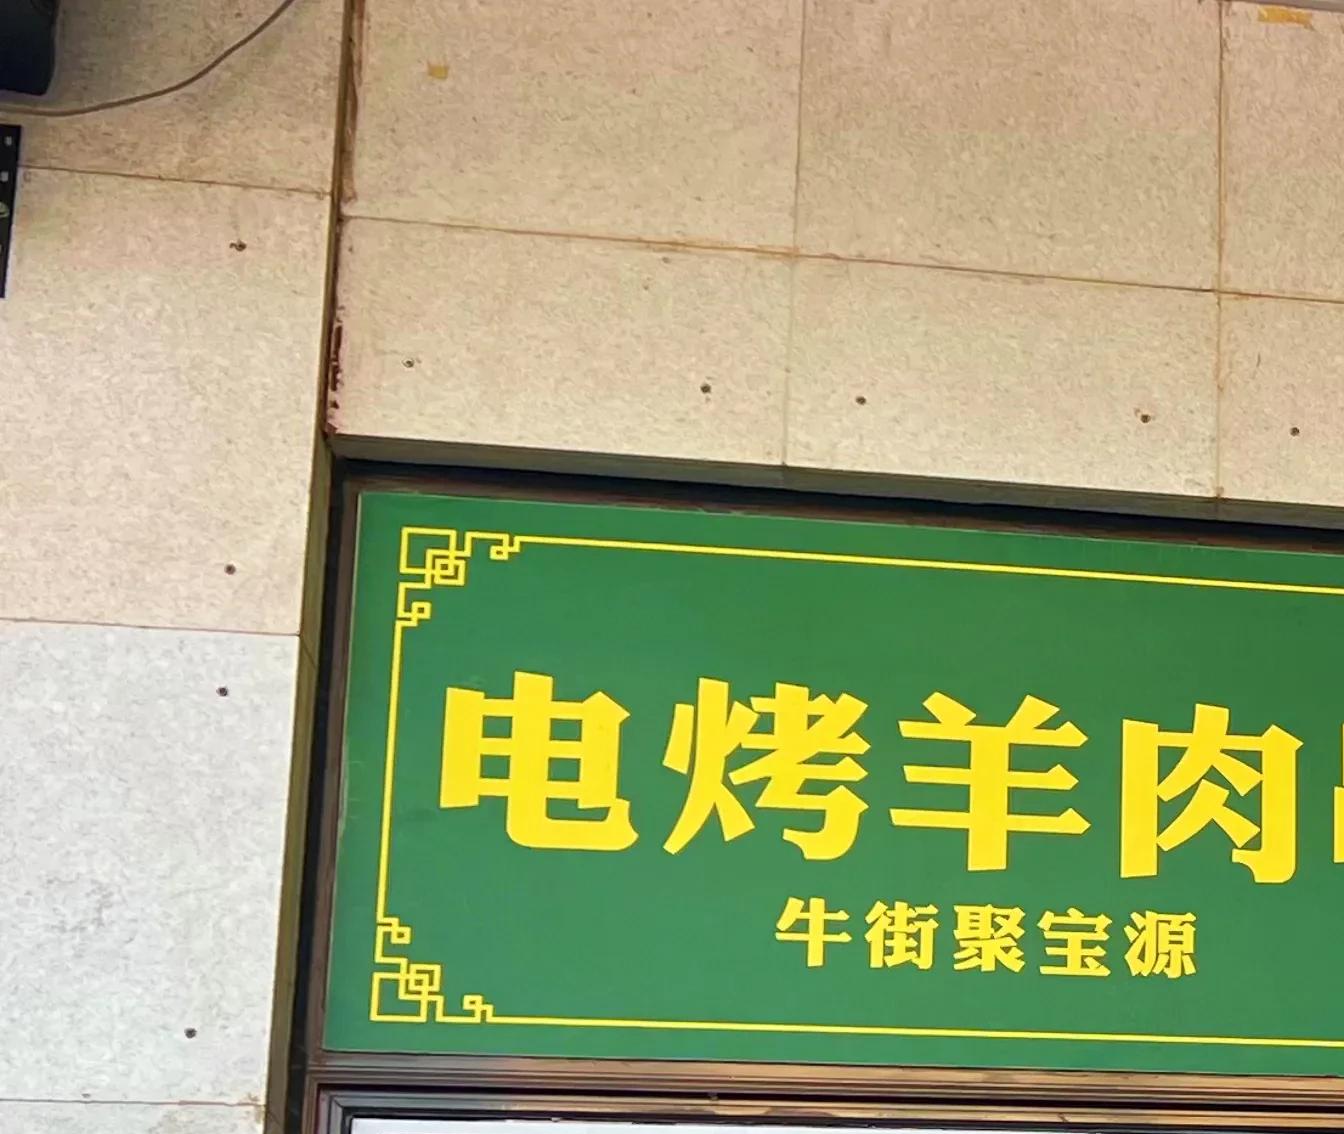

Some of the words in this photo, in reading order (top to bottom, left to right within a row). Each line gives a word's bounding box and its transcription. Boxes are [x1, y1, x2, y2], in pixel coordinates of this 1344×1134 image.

[774, 896, 1199, 979] 牛街聚宝源
